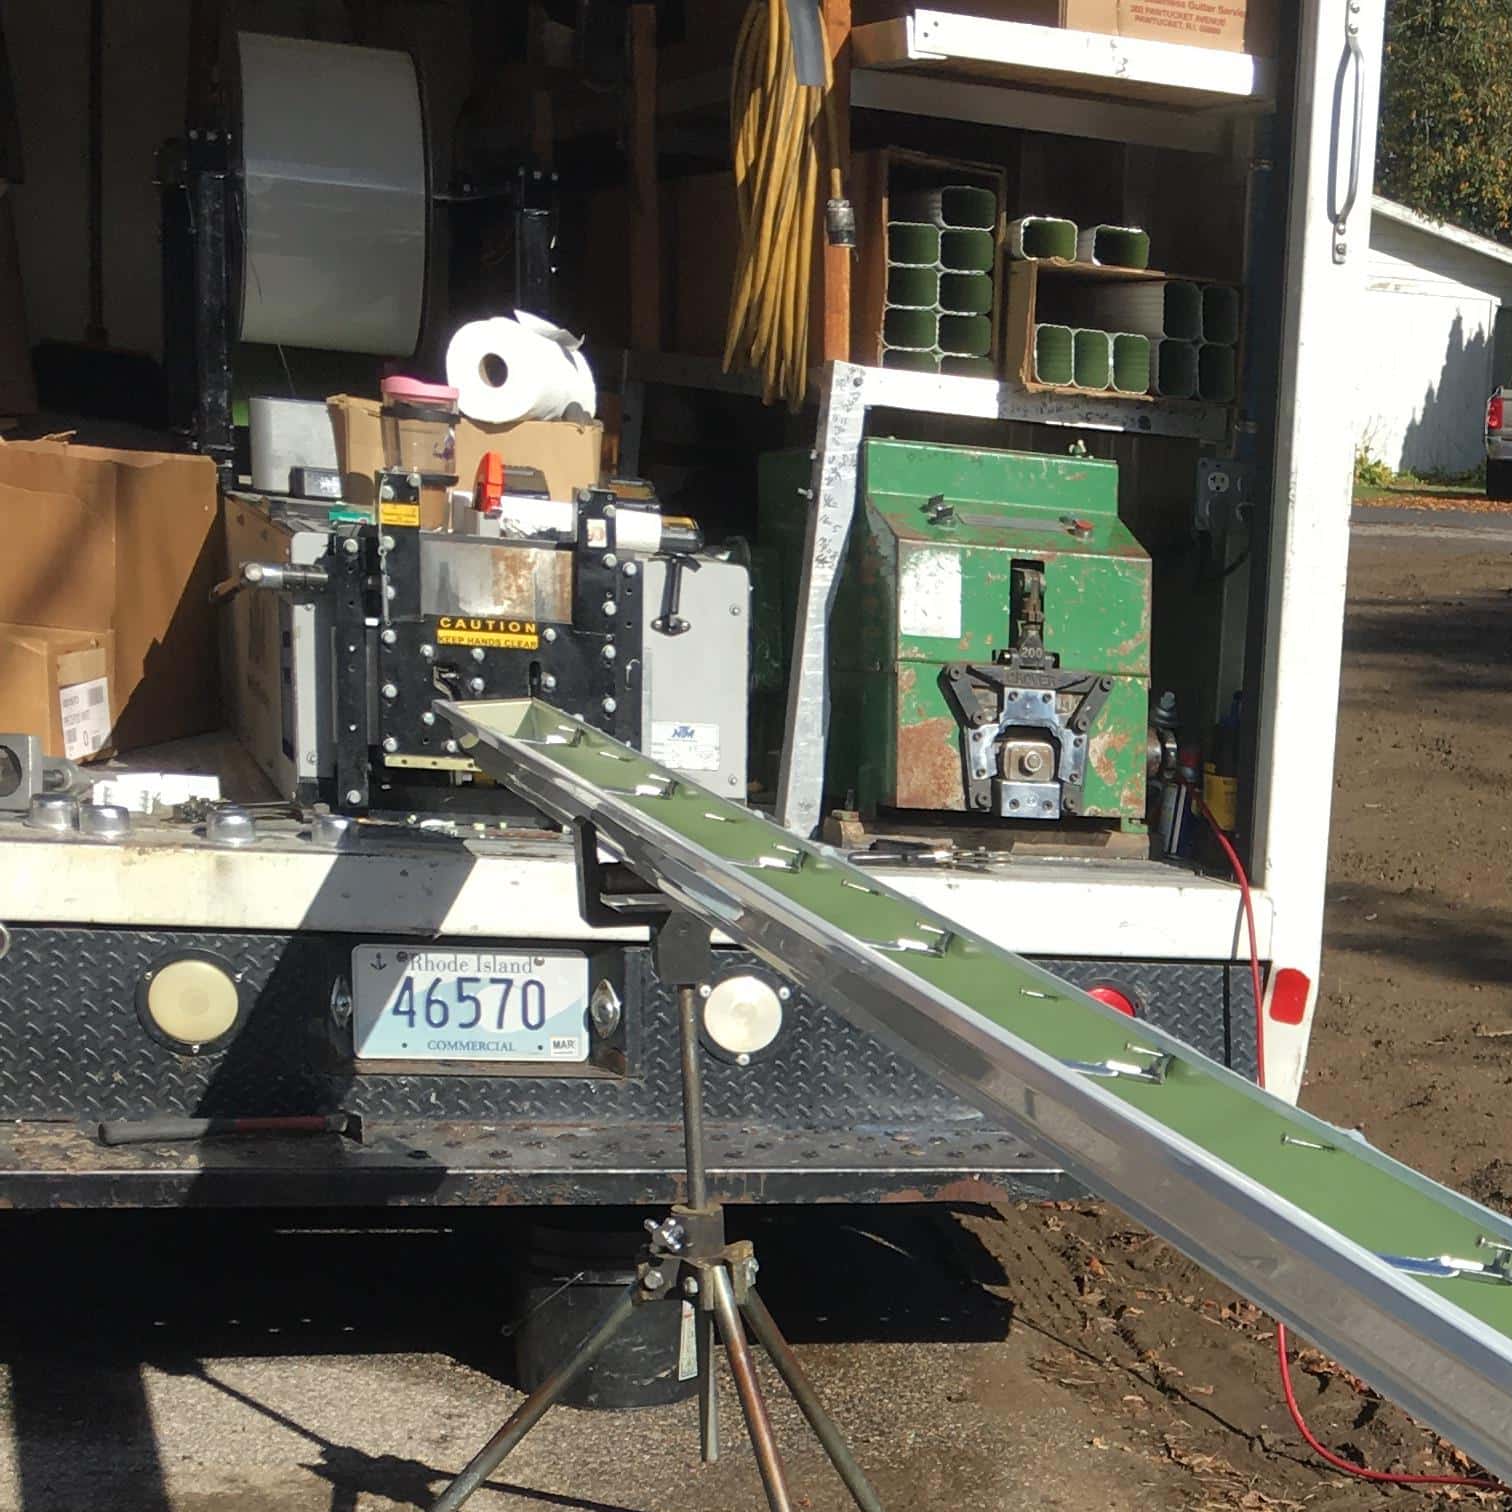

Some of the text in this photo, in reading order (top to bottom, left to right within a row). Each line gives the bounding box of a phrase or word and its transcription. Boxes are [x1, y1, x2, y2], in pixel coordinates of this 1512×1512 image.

[439, 617, 537, 633] CAUTION
[438, 635, 537, 649] KEEP HANDS CLEAR
[1021, 646, 1043, 658] 200
[409, 952, 534, 974] Rhode Island
[392, 975, 547, 1031] 46570
[426, 1039, 515, 1053] COMMERCIAL
[552, 1039, 577, 1050] MAR
